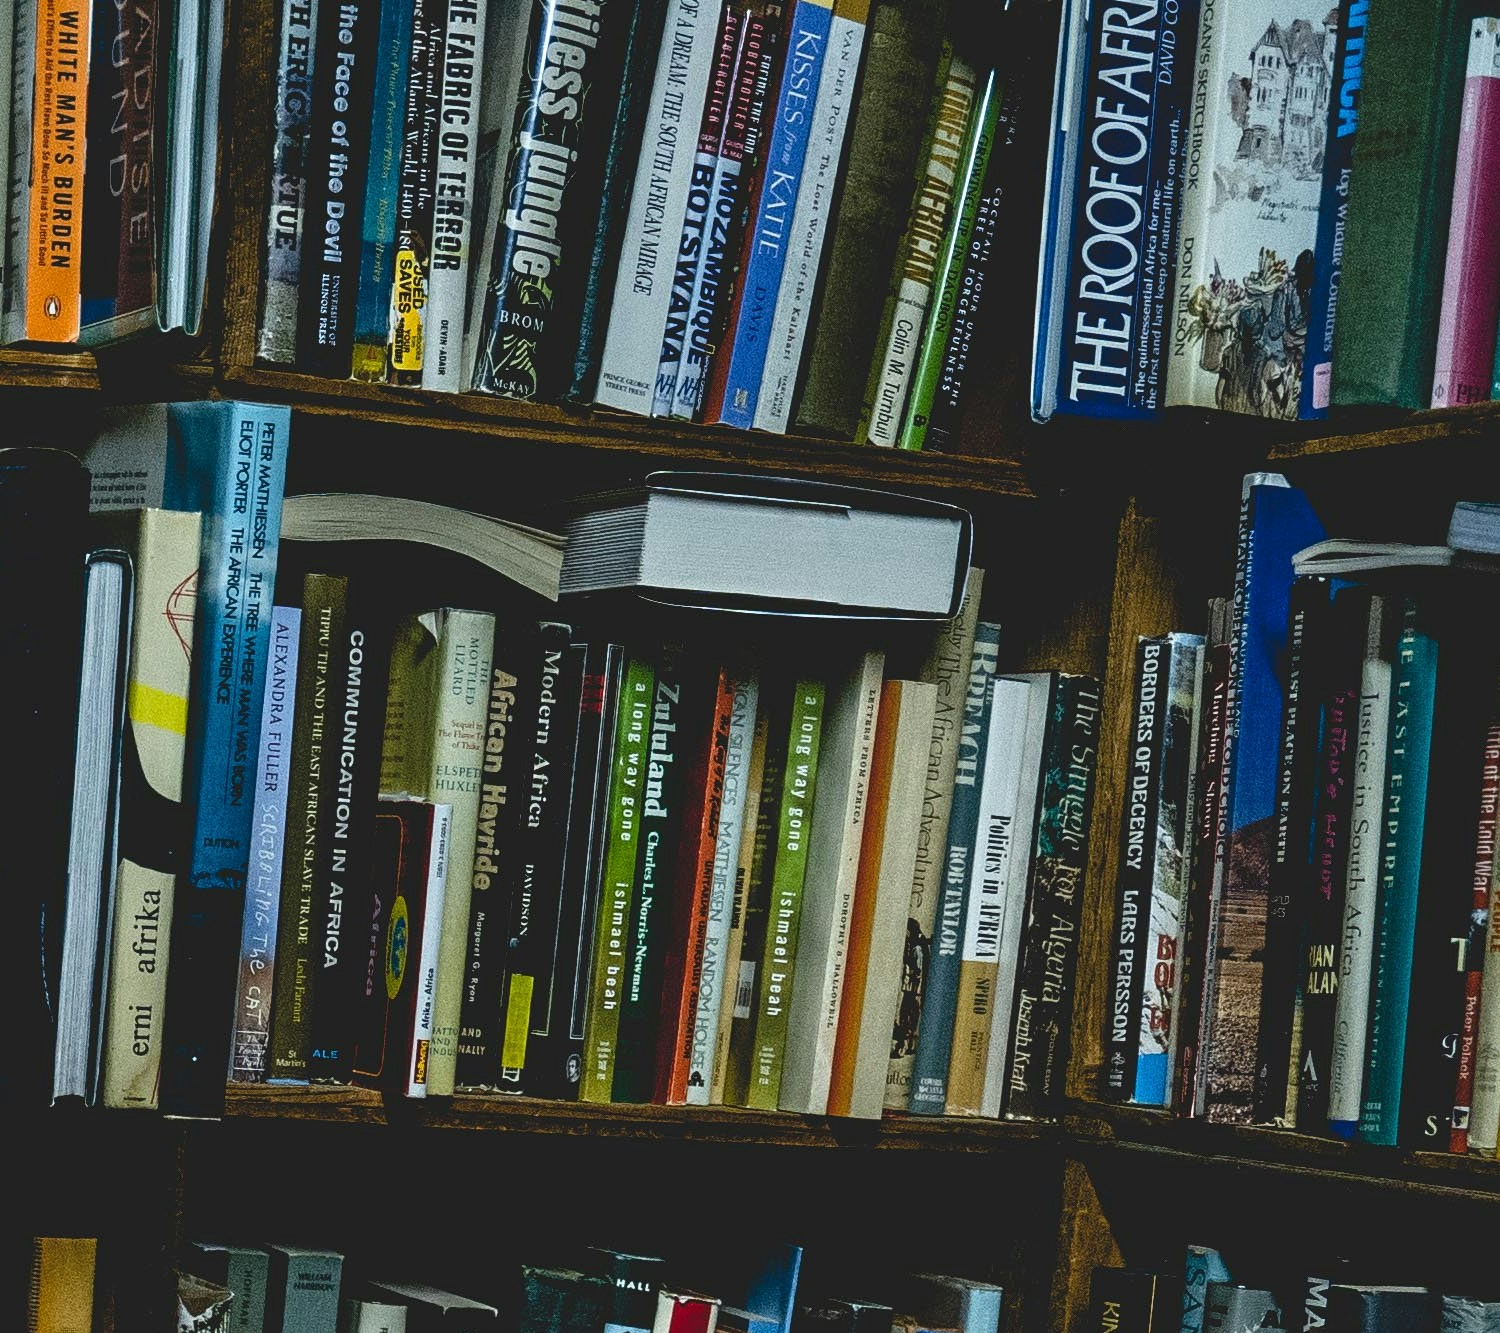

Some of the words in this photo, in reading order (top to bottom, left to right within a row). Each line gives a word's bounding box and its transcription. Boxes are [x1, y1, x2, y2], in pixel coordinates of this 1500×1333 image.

[55, 11, 78, 83] WHITE
[339, 6, 358, 44] the
[334, 51, 355, 114] Face
[442, 24, 478, 125] FABRIC
[783, 30, 822, 124] KISSES
[53, 95, 76, 166] MAN'S
[328, 152, 349, 194] the
[331, 120, 349, 148] of
[440, 130, 470, 163] OF
[779, 128, 804, 166] from
[1091, 97, 1150, 167] OF
[51, 175, 73, 270] BURDEN
[322, 203, 346, 264] Devil
[433, 168, 469, 271] TERROR
[758, 170, 796, 258] KATIE
[1080, 168, 1143, 304] ROOF
[660, 165, 714, 364] BOTSWANA
[682, 170, 741, 366] MOZAMBIQUE
[500, 309, 545, 334] BROM
[896, 319, 915, 355] Colin
[1069, 310, 1131, 403] THE
[873, 380, 907, 442] Turnbull
[334, 630, 365, 842] COMMUNICATION
[484, 668, 518, 775] African
[536, 649, 563, 747] Modern
[1138, 645, 1161, 740] BORDERS
[527, 751, 550, 830] Africa
[645, 680, 682, 819] Zululand
[333, 847, 352, 871] IN
[472, 781, 509, 891] Hayride
[1127, 775, 1150, 872] DECENCY
[322, 881, 345, 970] AFRICA
[1120, 889, 1141, 949] LARS
[1113, 951, 1136, 1043] PERSSON
